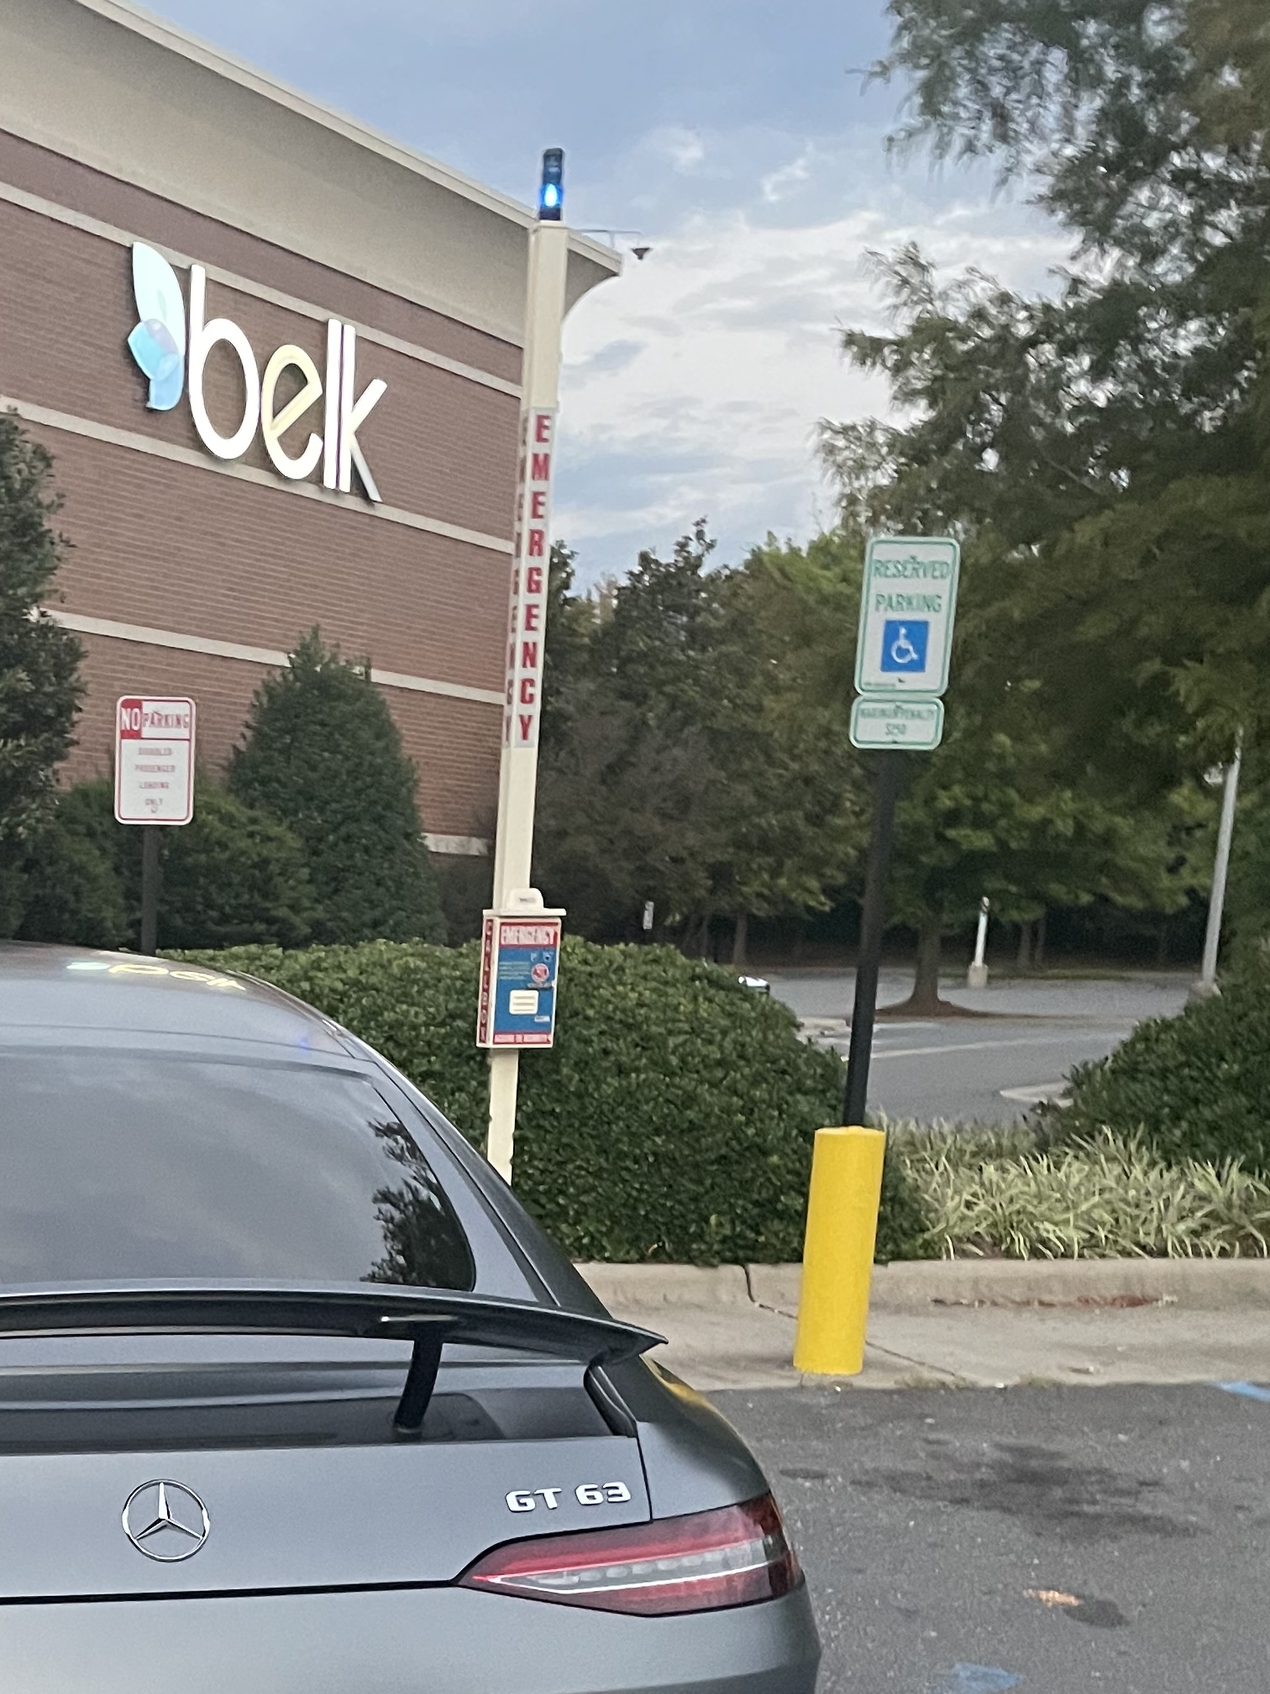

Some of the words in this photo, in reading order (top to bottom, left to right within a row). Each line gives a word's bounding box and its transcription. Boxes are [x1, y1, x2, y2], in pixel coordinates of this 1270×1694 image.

[188, 264, 388, 502] belk
[519, 415, 552, 741] EMERGENCY
[872, 558, 950, 580] RESERVED
[875, 593, 942, 613] PARKING
[120, 708, 141, 731] NO
[142, 712, 190, 729] PARKING
[505, 1488, 563, 1513] GT
[575, 1481, 632, 1506] 63
